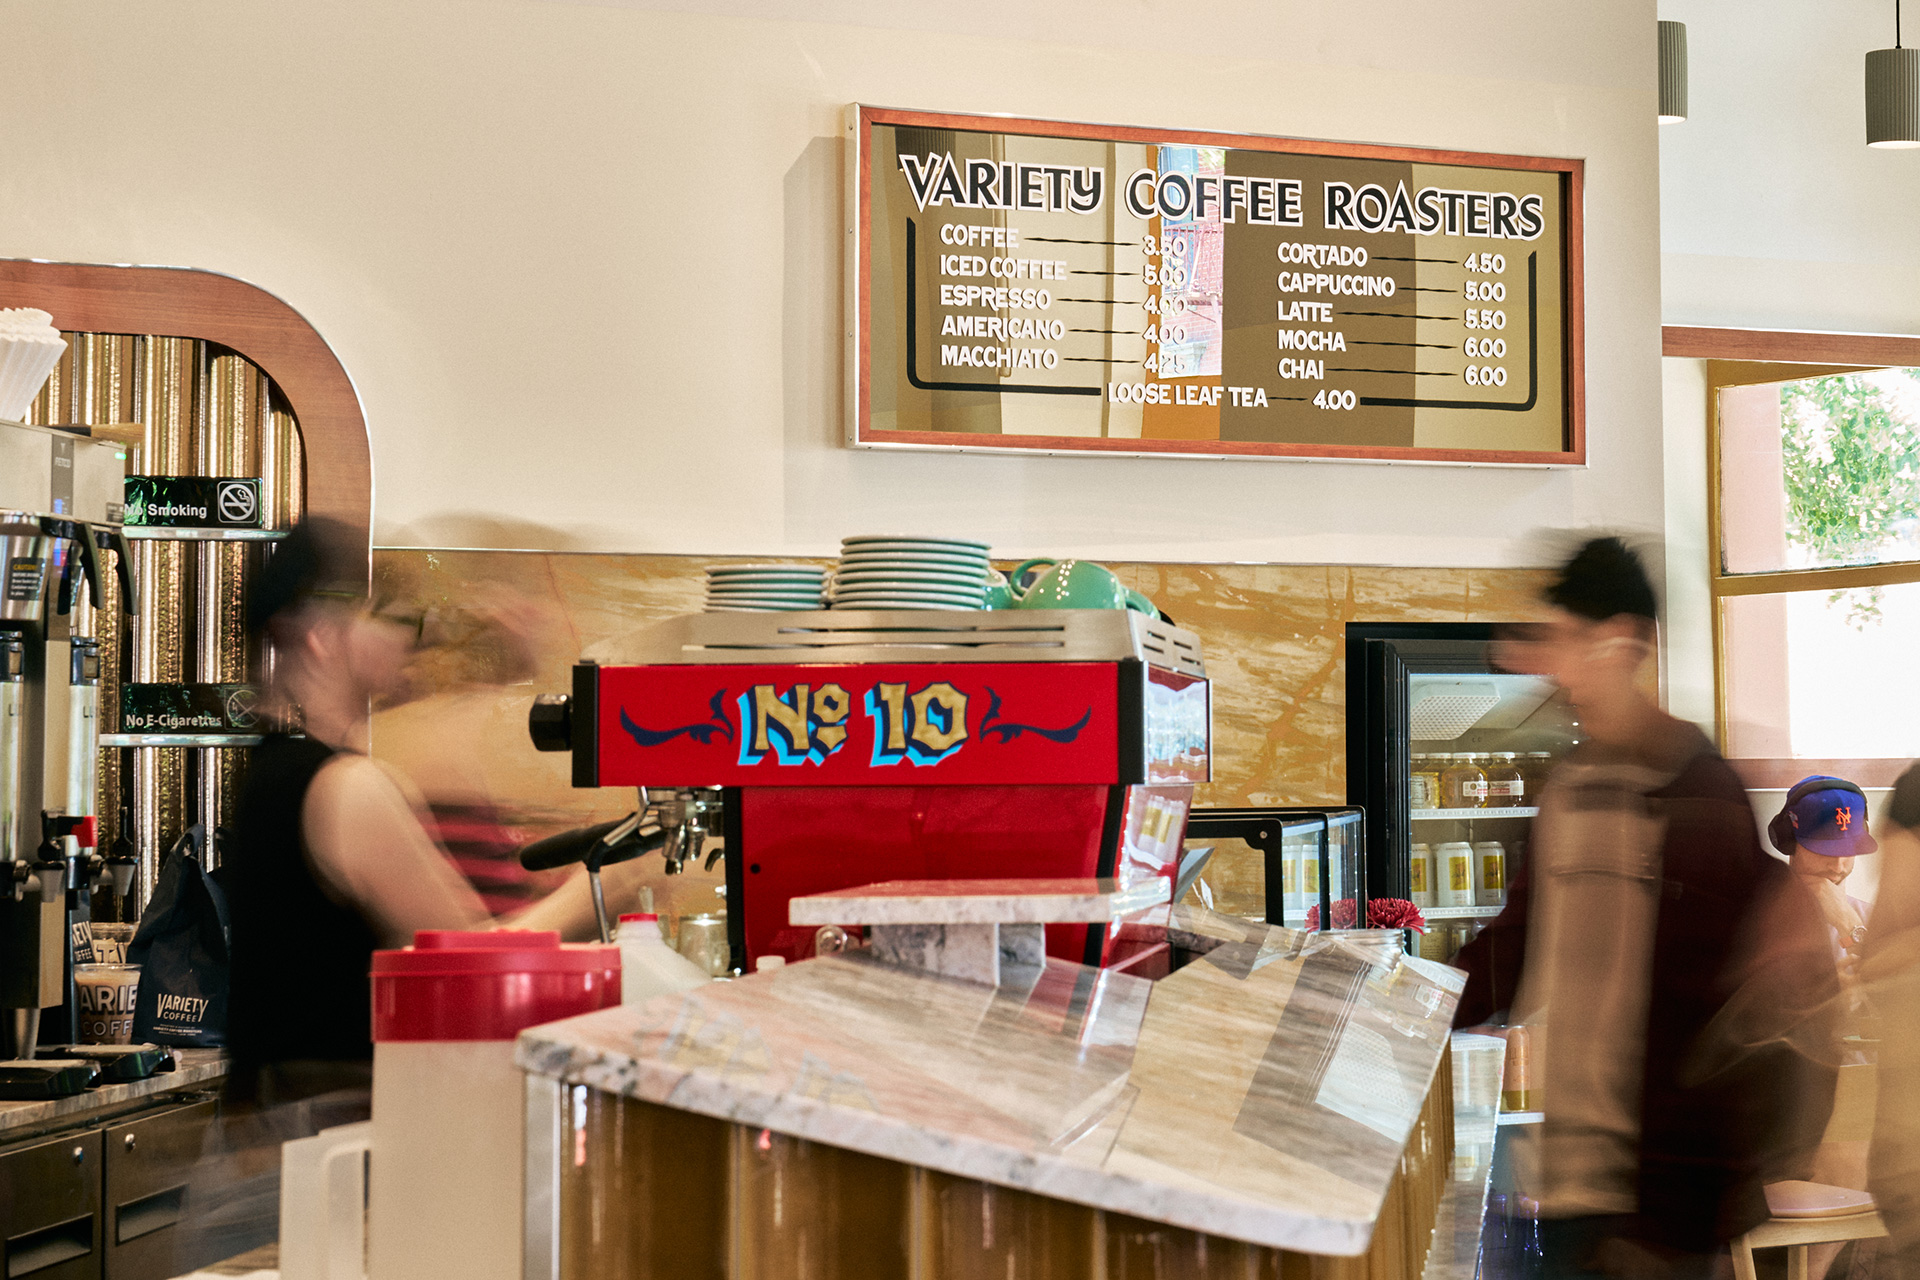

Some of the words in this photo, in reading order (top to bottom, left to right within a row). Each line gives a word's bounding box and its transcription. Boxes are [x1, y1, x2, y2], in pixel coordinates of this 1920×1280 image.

[900, 151, 1104, 215] VARIETY
[1124, 168, 1303, 226] COFFEE
[1324, 179, 1545, 240] ROASTERS
[940, 223, 1019, 248] COFFEE
[1143, 235, 1188, 256] 3.50
[940, 254, 988, 277] ICED
[989, 256, 1067, 280] COFFEE
[1143, 264, 1188, 286] 5.00
[1277, 242, 1368, 269] CORTADO
[1464, 253, 1506, 274] 4.50
[940, 284, 1051, 311] ESPRESSO
[1143, 294, 1188, 315] 4.00
[1277, 271, 1395, 297] CAPPUCCINO
[1464, 281, 1506, 302] 5.00
[941, 315, 1066, 342] AMERICANO
[1143, 324, 1188, 345] 4.00
[1277, 300, 1333, 323] LATTE
[1464, 309, 1506, 330] 5.50
[940, 344, 1059, 370] MACCHIATO
[1143, 353, 1187, 374] 4.25
[1278, 330, 1347, 352] MOCHA
[1464, 337, 1506, 359] 6.00
[1278, 358, 1324, 380] CHAI
[1464, 366, 1507, 388] 6.00
[1107, 382, 1171, 405] LOOSE
[1175, 385, 1224, 406] LEAF
[1228, 386, 1268, 408] TEA
[1312, 389, 1356, 411] 4.00
[124, 504, 144, 516] No
[147, 503, 207, 519] Smoking
[126, 714, 144, 727] No
[146, 714, 222, 729] E-Cigarettes
[864, 681, 969, 767] 10
[80, 985, 138, 1015] ARIE
[157, 993, 209, 1023] VARIETY
[83, 1020, 134, 1036] COFF
[163, 1011, 198, 1023] COFFEE
